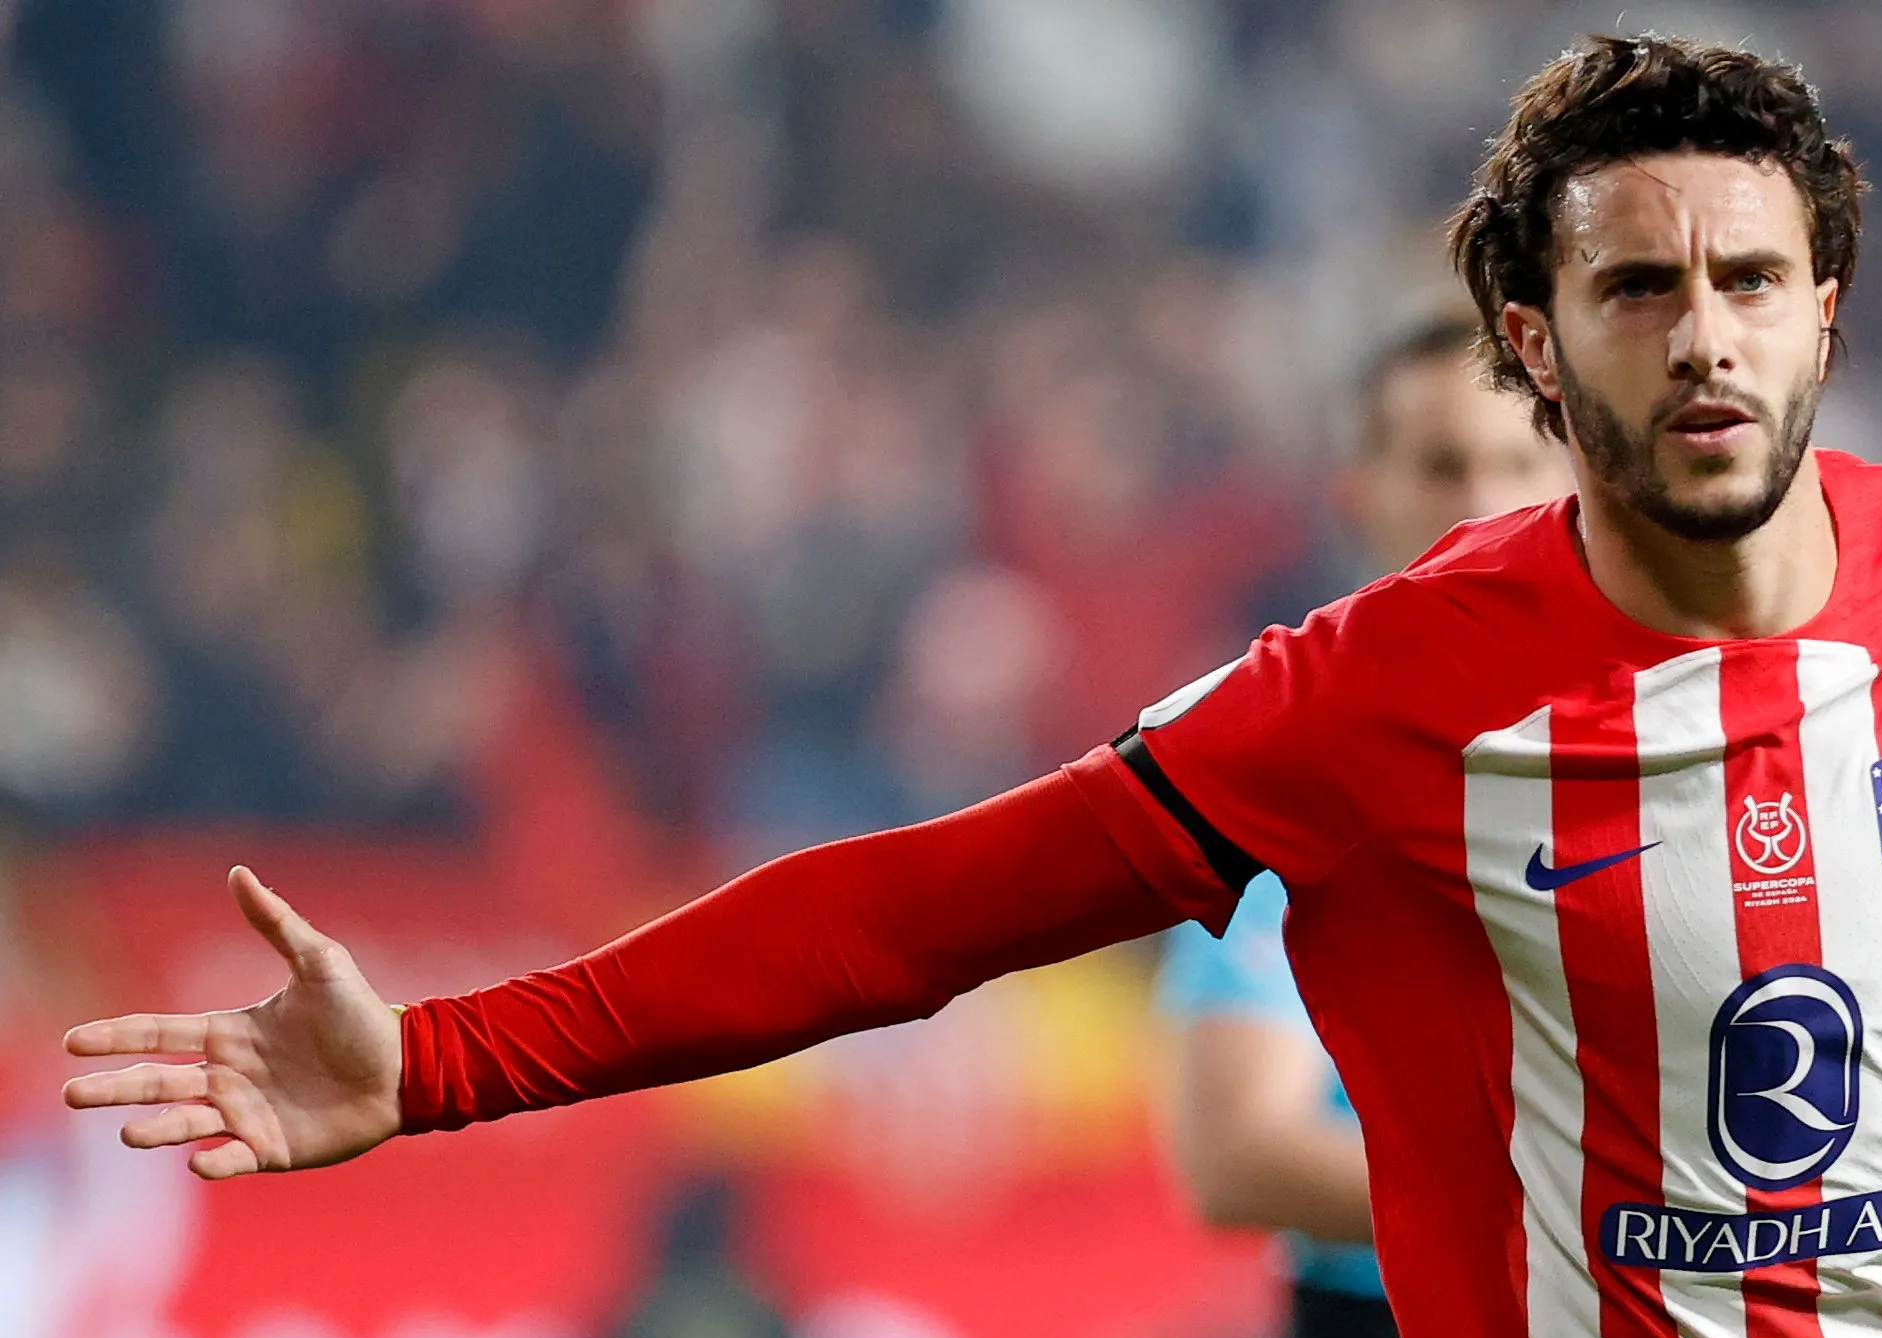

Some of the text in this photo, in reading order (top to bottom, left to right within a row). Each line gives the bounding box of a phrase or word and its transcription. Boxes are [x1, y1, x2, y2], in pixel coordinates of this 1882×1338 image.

[1760, 811, 1777, 820] RF
[1733, 876, 1815, 892] SUPERCOPA
[1765, 888, 1798, 897] ESPAÑA
[1744, 898, 1780, 907] RIYADH
[1616, 1208, 1830, 1264] RIYADH
